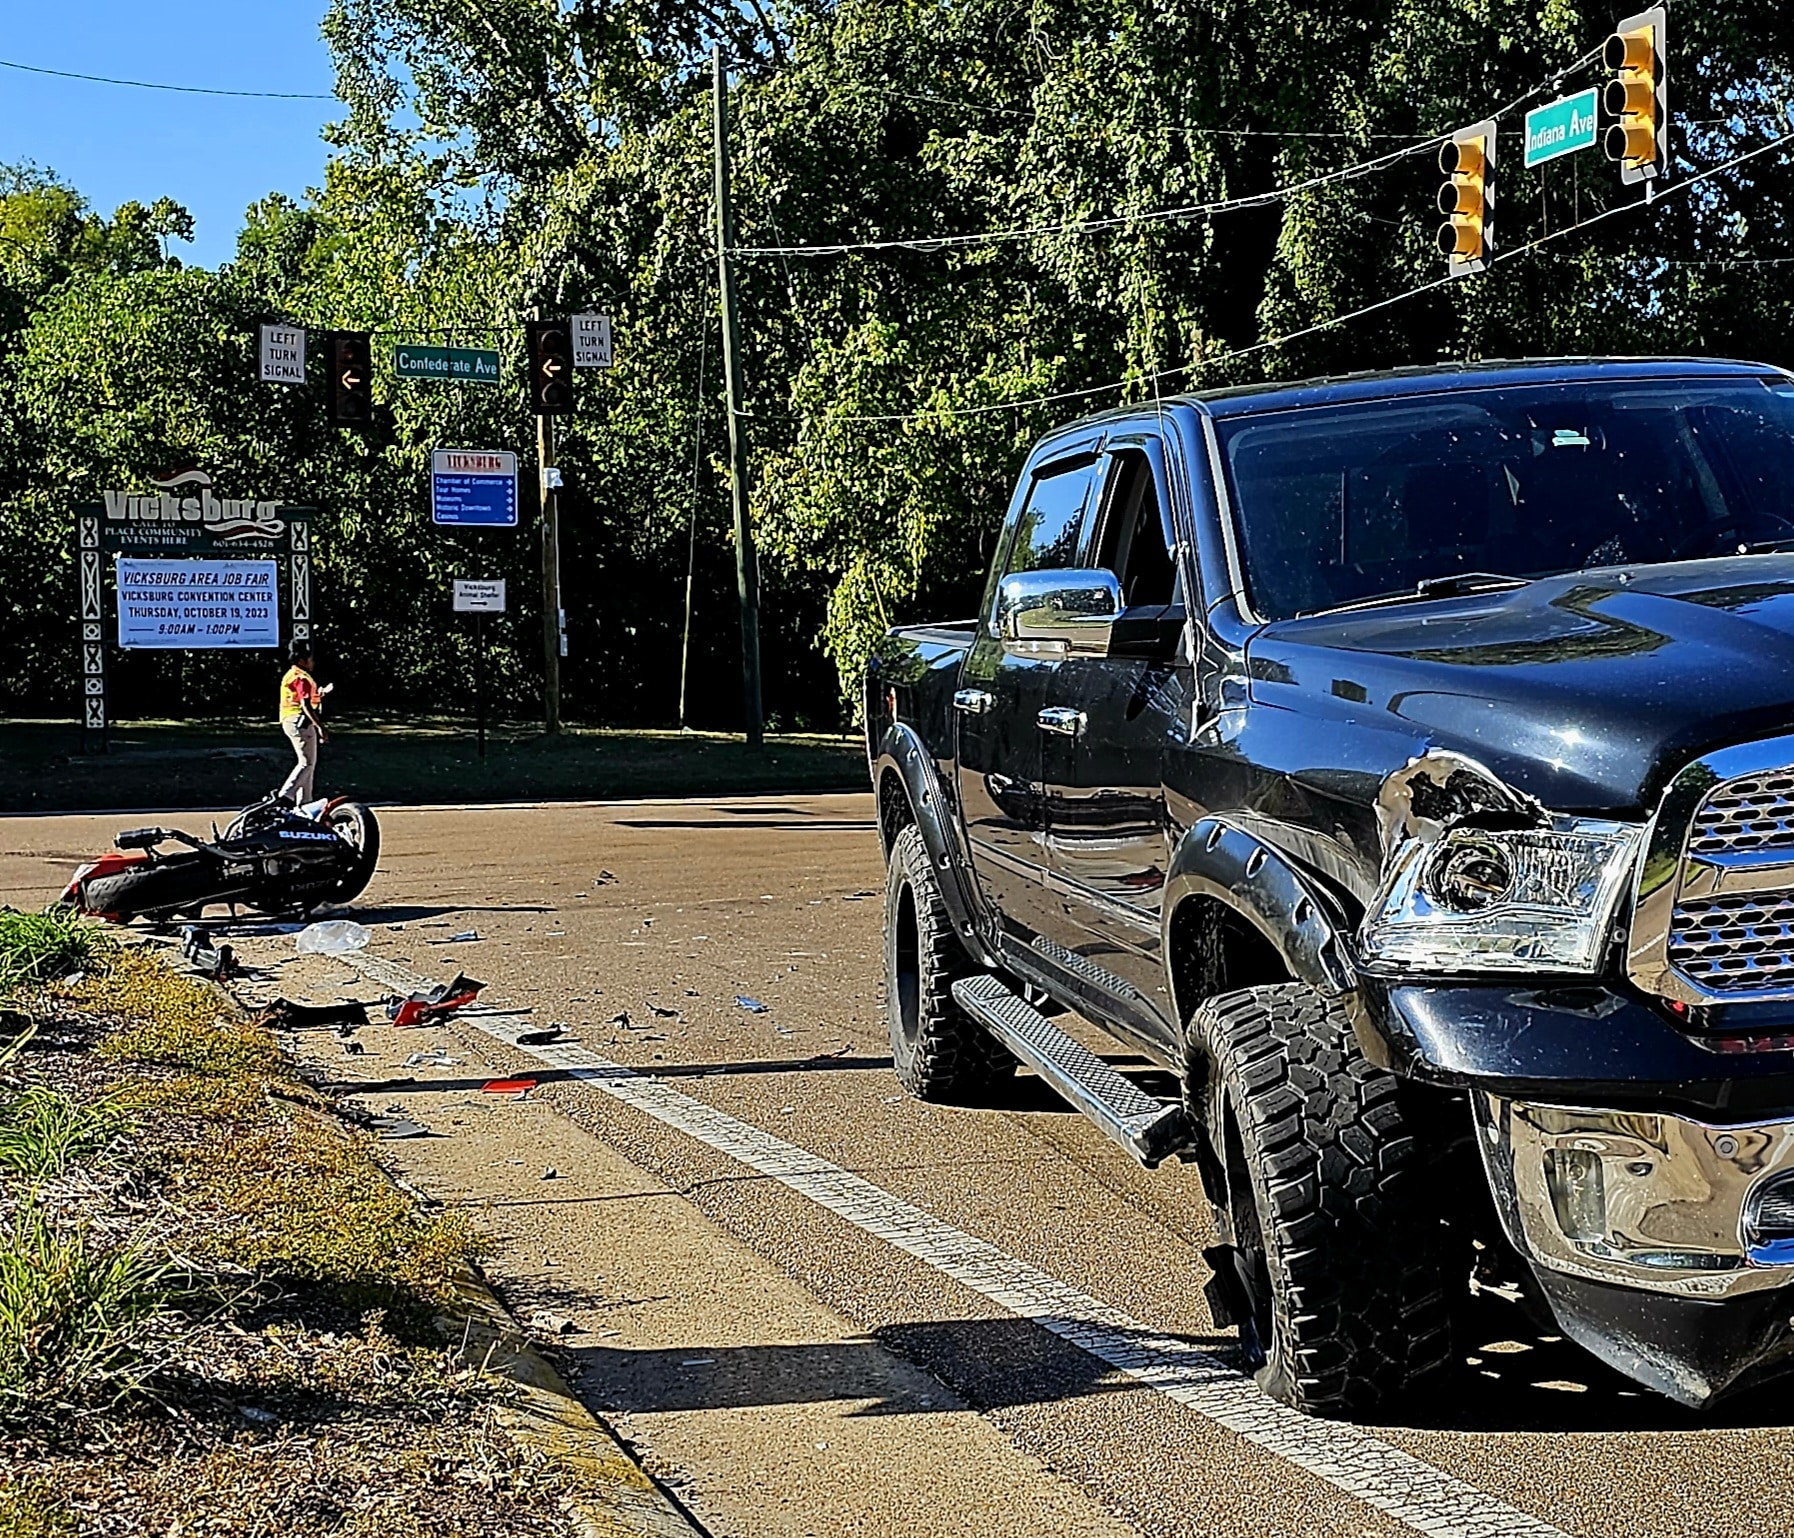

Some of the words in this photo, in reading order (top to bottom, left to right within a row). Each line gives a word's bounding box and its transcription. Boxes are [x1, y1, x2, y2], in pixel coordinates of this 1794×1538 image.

[1527, 124, 1565, 152] Indiana
[1569, 108, 1593, 137] Ave
[580, 320, 602, 331] LEFT
[270, 331, 296, 345] LEFT
[579, 335, 604, 347] TURN
[270, 348, 297, 361] TURN
[576, 351, 609, 362] SIGNAL
[399, 353, 471, 372] Confederate
[475, 357, 497, 374] Ave
[264, 364, 302, 378] SIGNAL
[447, 454, 502, 469] VICKSBURG
[103, 489, 284, 531] Vicksburg
[105, 527, 135, 536] PLACE
[138, 528, 202, 537] COMMUNITY
[121, 535, 159, 545] EVENTS
[162, 536, 188, 545] HERE
[124, 571, 187, 584] VICKSBURG
[189, 572, 218, 585] AREA
[222, 573, 243, 585] JOB
[245, 573, 269, 585] FAIR
[121, 590, 174, 601] VICKSBURG
[177, 591, 235, 602] CONVENTION
[238, 592, 273, 602] CENTER
[128, 606, 182, 619] THURSDAY,
[184, 607, 227, 618] OCTOBER
[230, 607, 243, 619] 19,
[245, 608, 268, 619] 2023
[158, 623, 196, 635] 9:00AM
[206, 623, 240, 635] 1:00PM
[278, 830, 338, 841] SUZUKI
